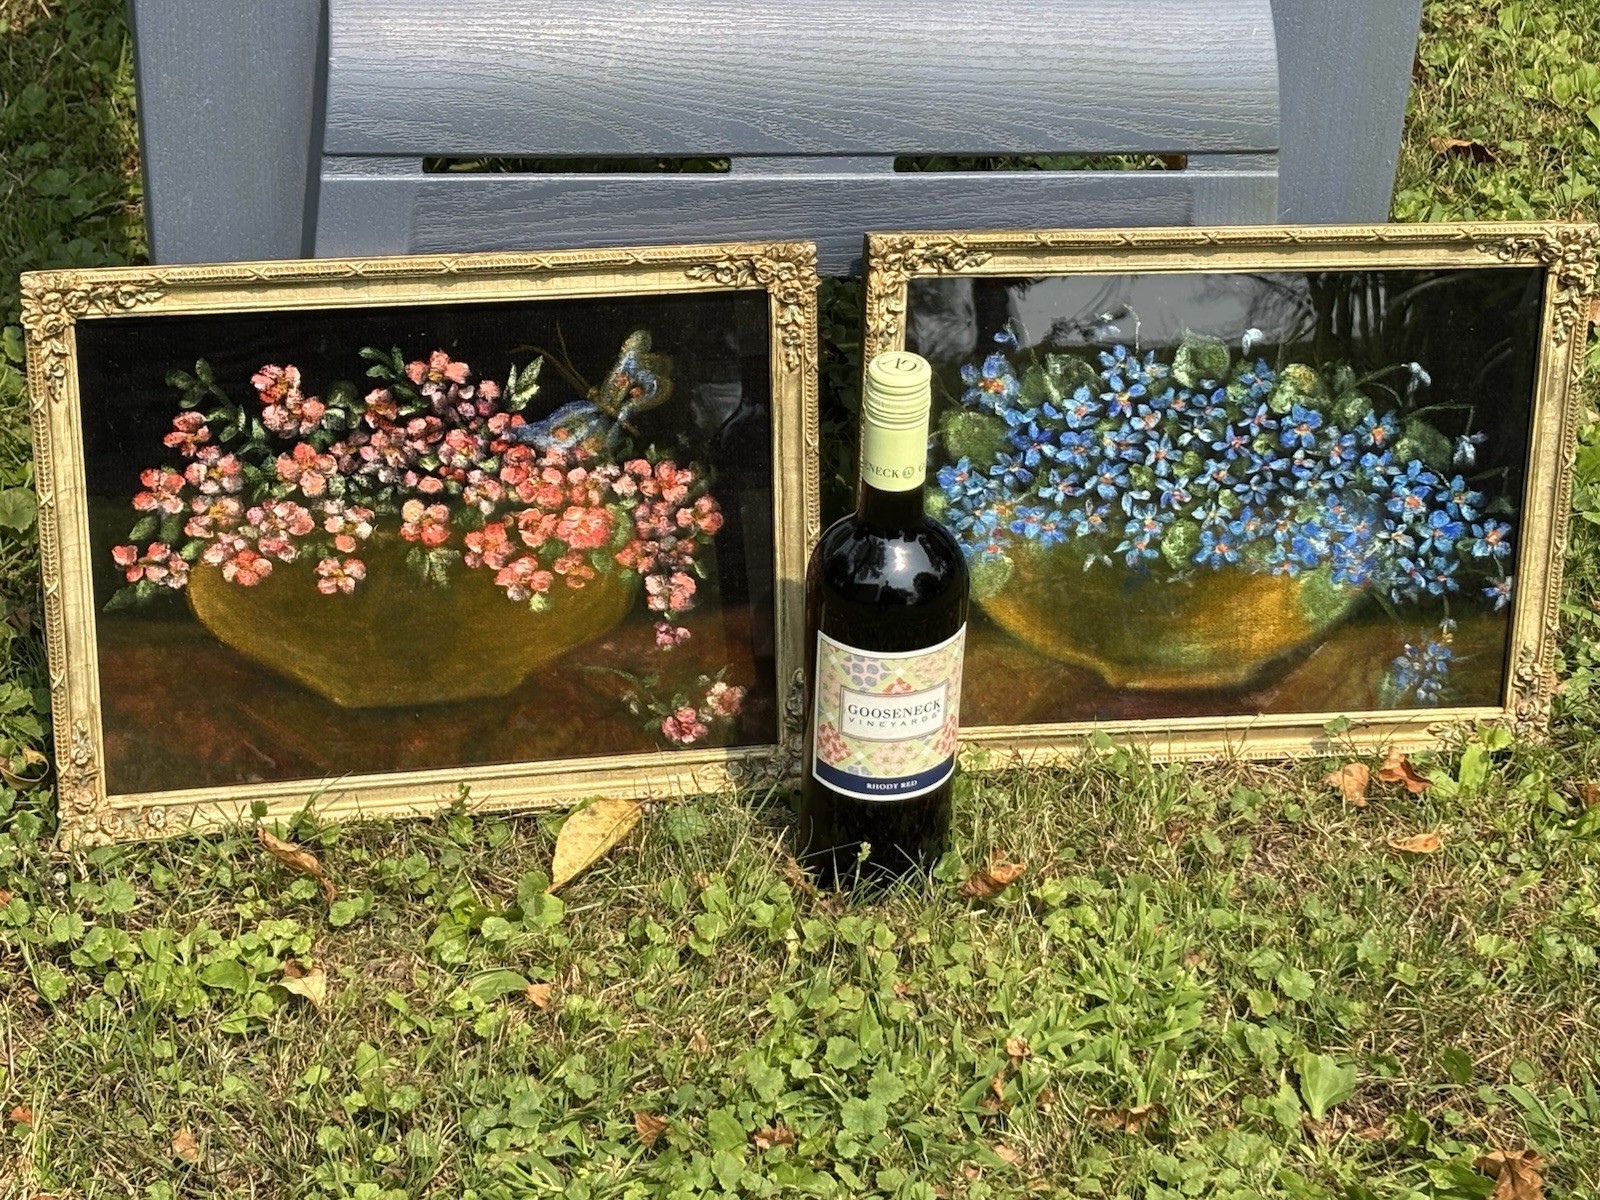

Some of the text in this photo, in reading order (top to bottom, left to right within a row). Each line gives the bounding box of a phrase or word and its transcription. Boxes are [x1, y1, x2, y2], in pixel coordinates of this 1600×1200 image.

[848, 699, 941, 719] GOOSENECK
[849, 713, 938, 727] VINEYARDS
[866, 780, 918, 791] RHODY RED
